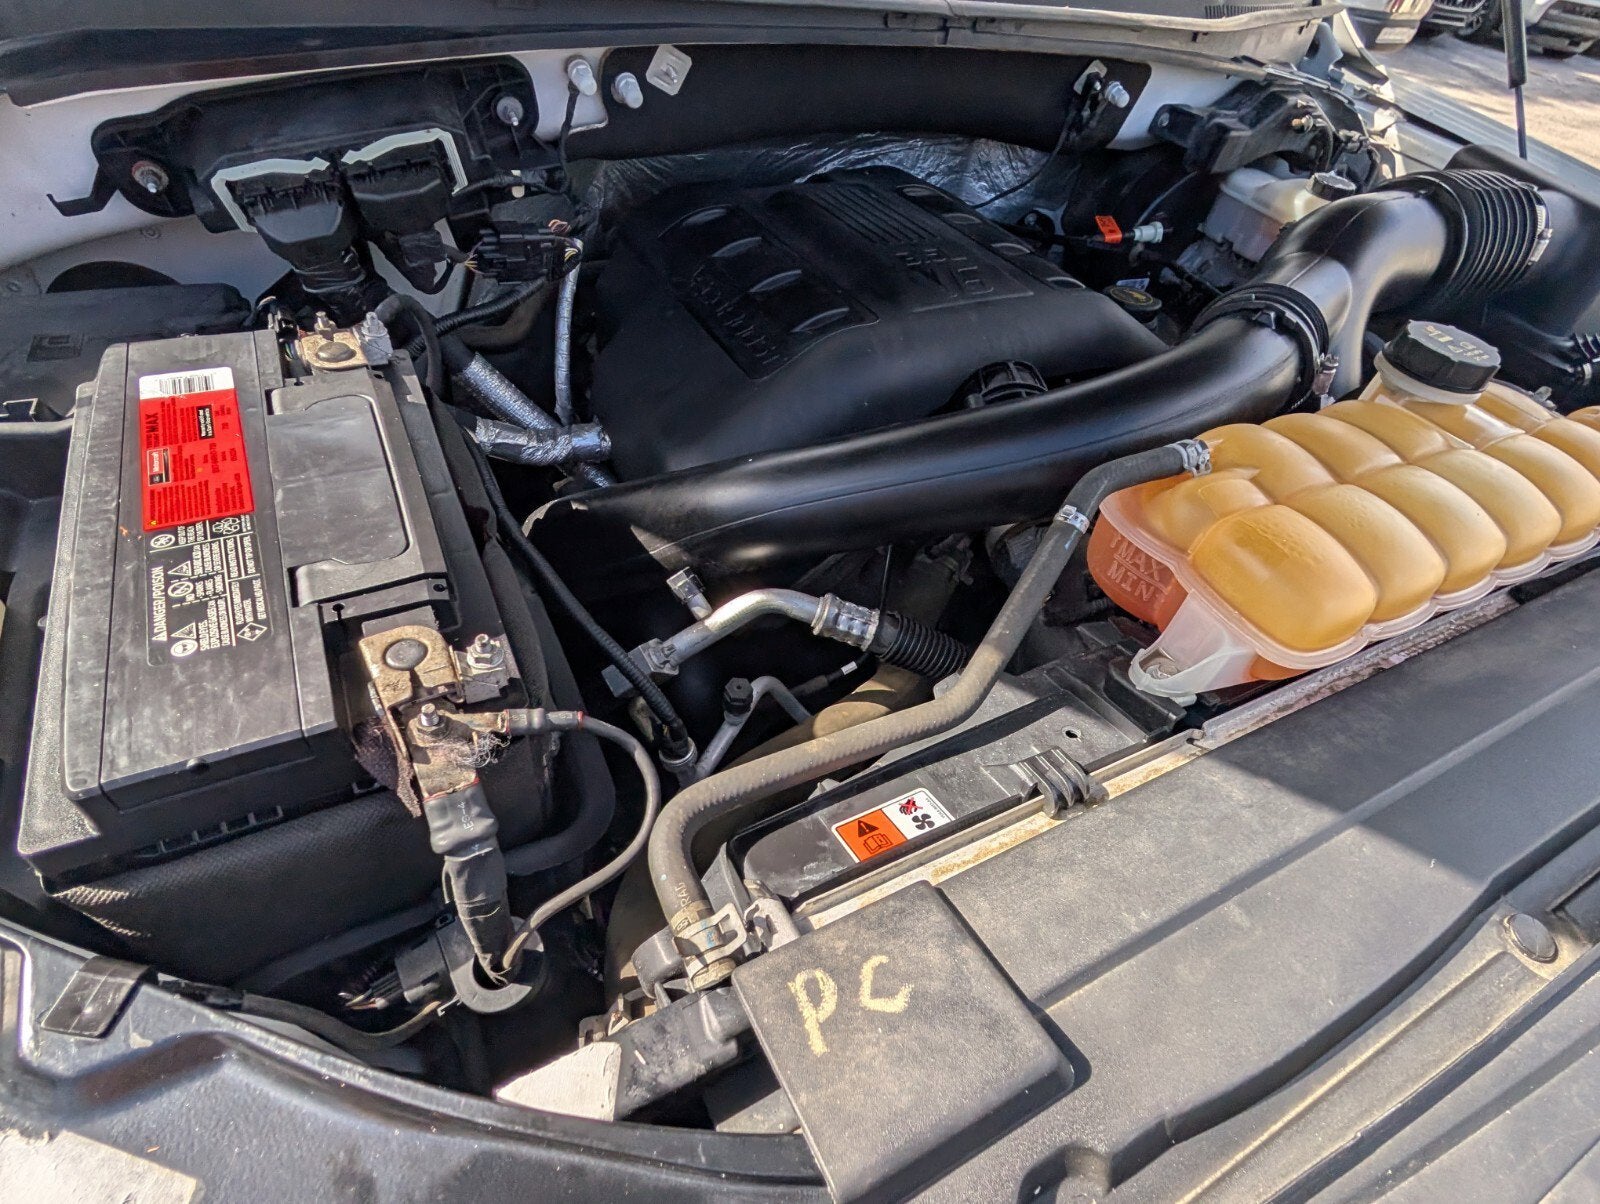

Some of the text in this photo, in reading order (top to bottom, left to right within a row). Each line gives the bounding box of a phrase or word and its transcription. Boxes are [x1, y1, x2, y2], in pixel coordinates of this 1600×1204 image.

[144, 412, 158, 433] MAX
[151, 451, 159, 472] Motorcraft
[1107, 559, 1155, 602] MIN
[1117, 540, 1164, 582] MAX
[150, 565, 167, 633] DANGER/POISON
